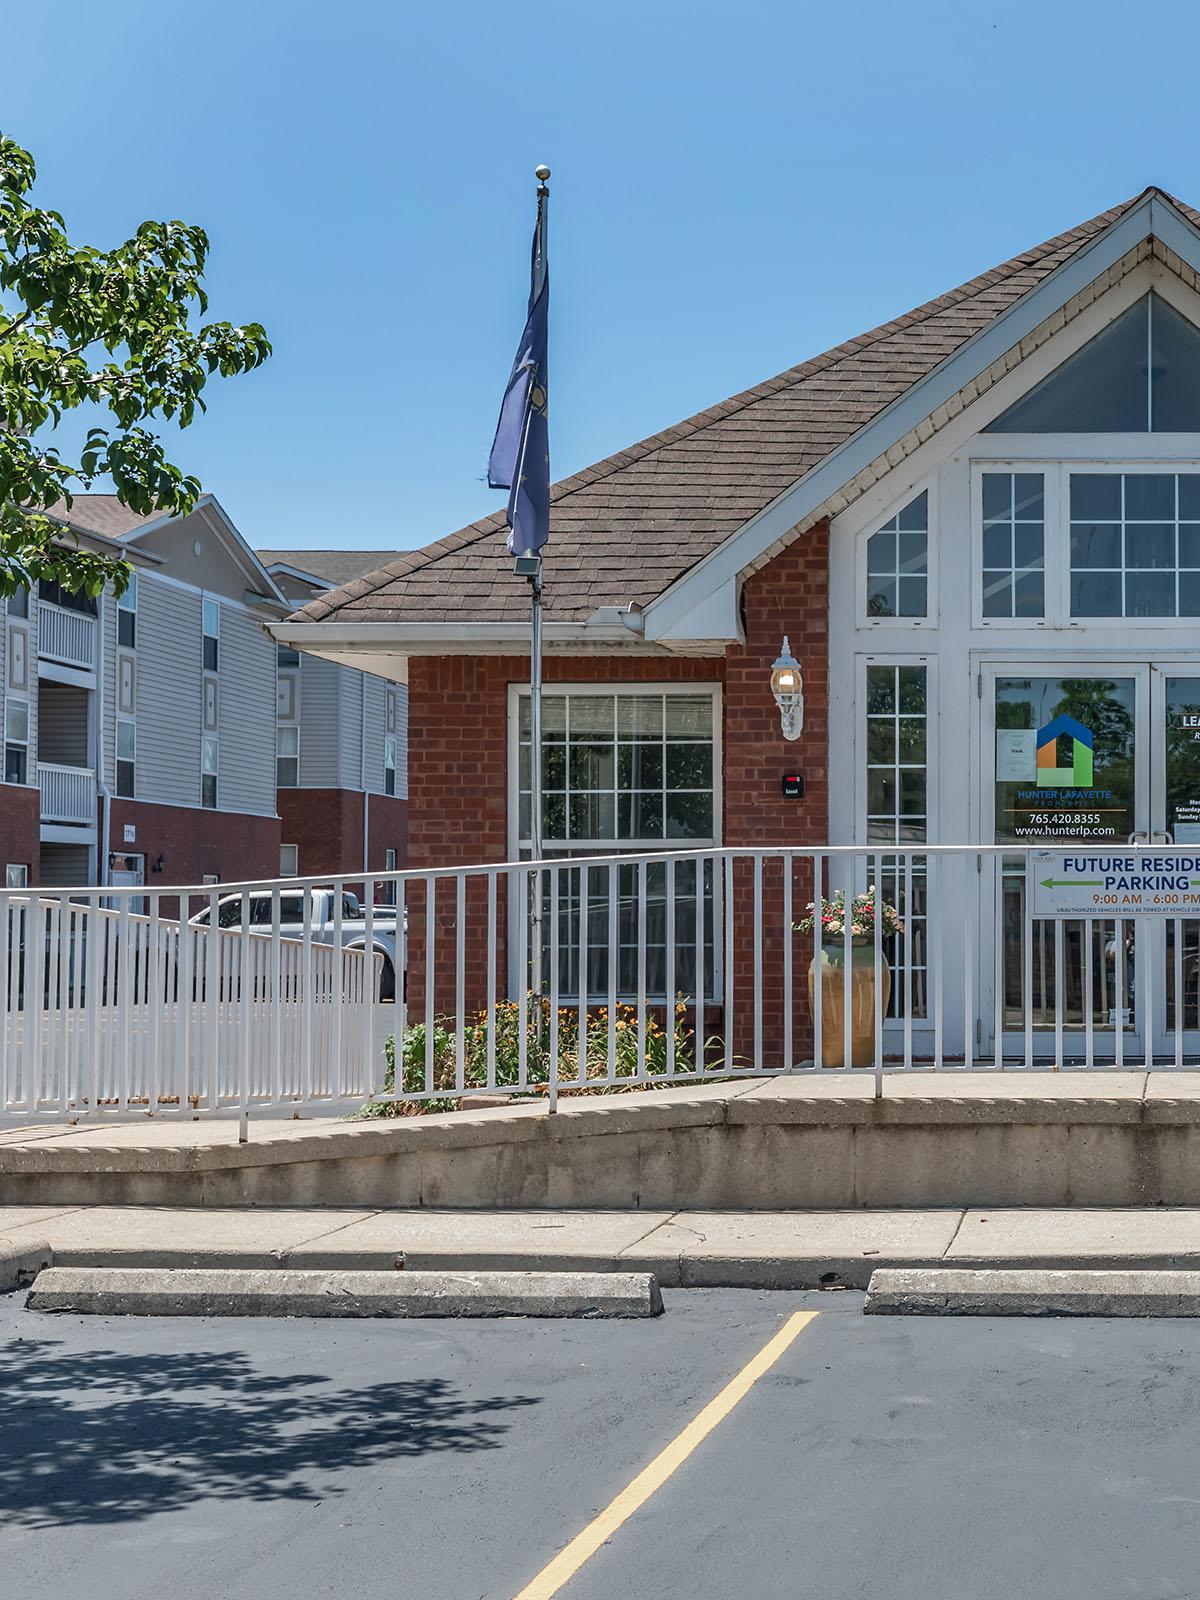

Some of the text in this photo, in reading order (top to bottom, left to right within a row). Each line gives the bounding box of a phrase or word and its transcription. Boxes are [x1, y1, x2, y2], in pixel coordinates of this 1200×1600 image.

[1018, 791, 1057, 799] HUNTER
[1030, 814, 1100, 824] 765.420.8355
[1015, 825, 1115, 837] www.hunterlp.com
[1063, 858, 1135, 872] FUTURE
[1105, 877, 1190, 890] PARKING
[1093, 895, 1118, 904] 9:00
[1122, 895, 1142, 904] AM
[1153, 895, 1179, 904] 6:00
[1183, 895, 1200, 904] PM
